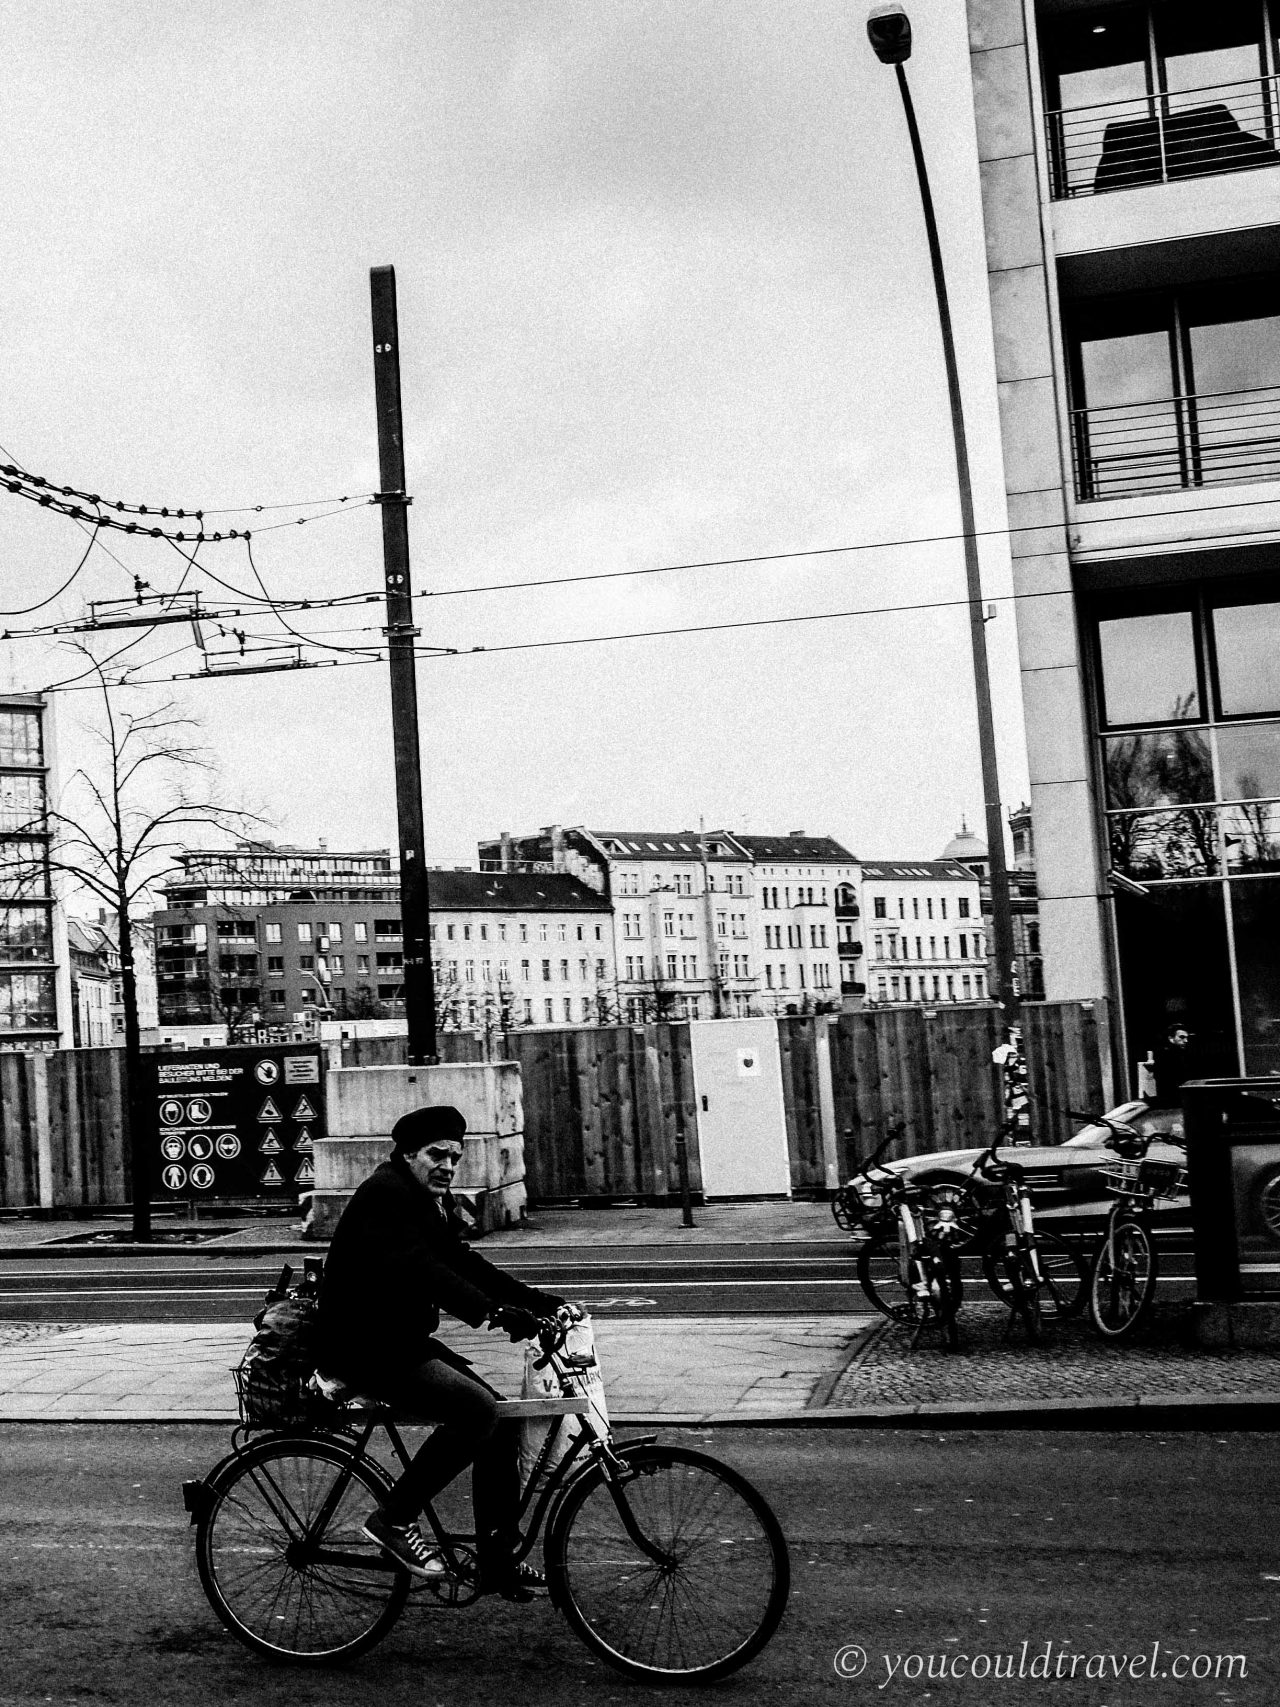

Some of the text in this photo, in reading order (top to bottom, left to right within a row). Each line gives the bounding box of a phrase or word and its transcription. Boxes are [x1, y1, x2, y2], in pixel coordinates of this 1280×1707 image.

[204, 1062, 221, 1070] UND
[158, 1070, 195, 1078] BESUCHER
[228, 1067, 244, 1075] DER
